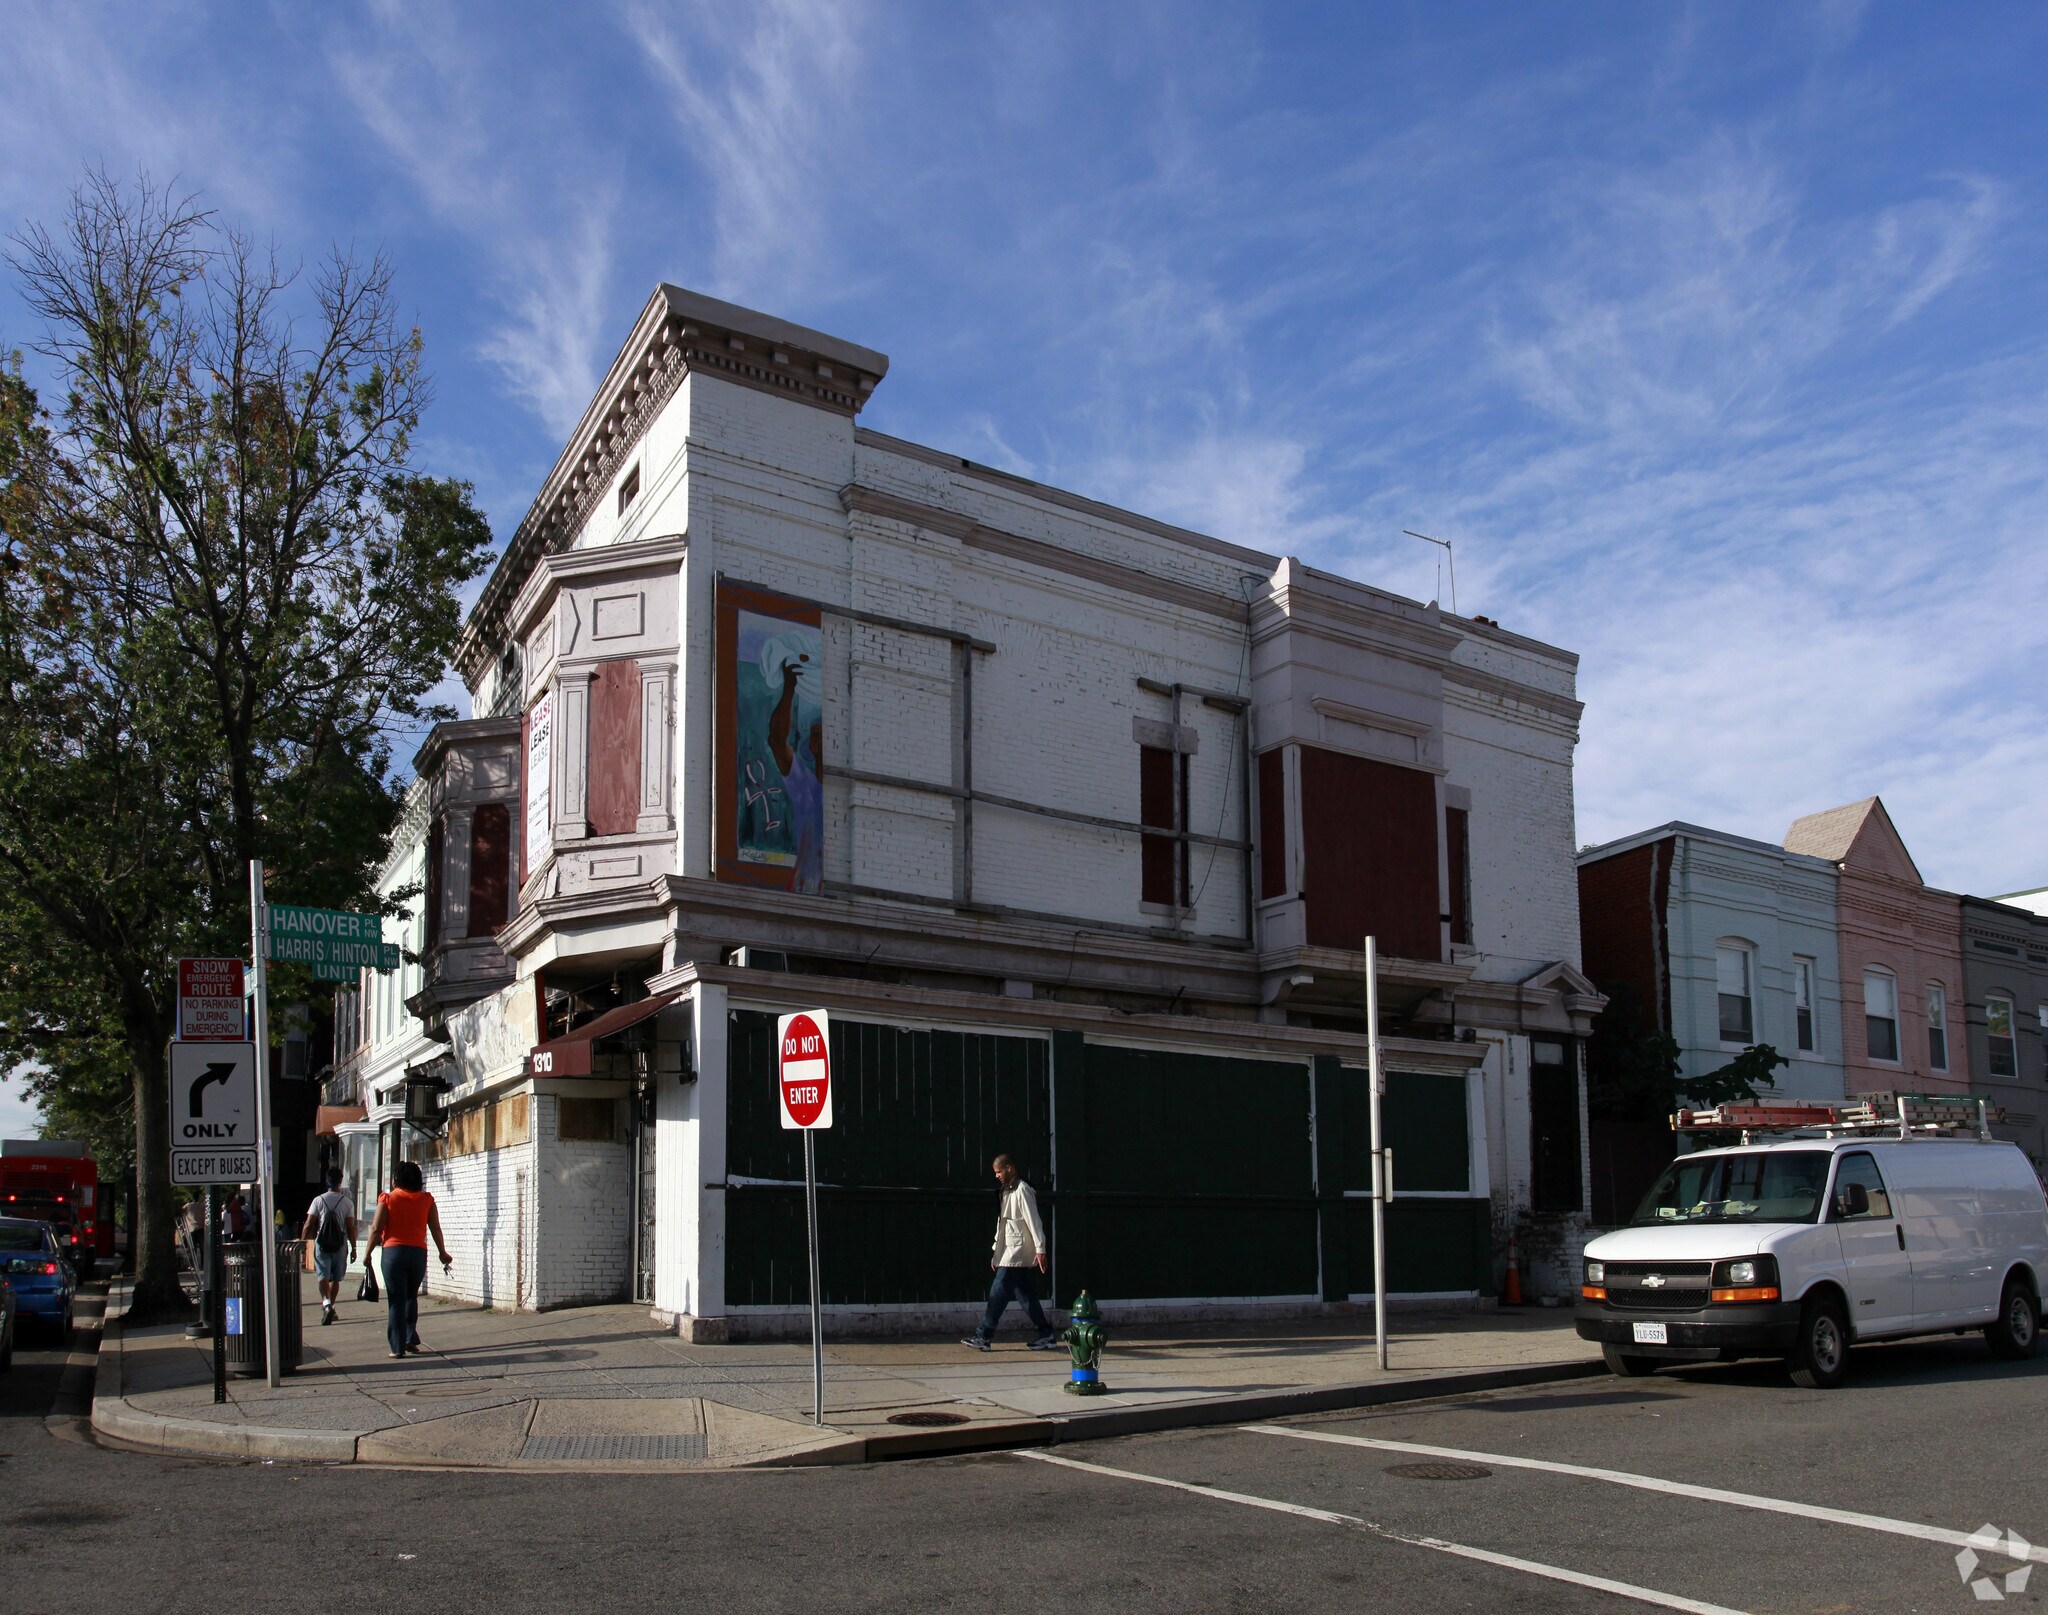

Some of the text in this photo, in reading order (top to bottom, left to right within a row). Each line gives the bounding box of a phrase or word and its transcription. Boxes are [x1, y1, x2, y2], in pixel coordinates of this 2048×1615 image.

[530, 697, 551, 732] LEASE
[530, 721, 550, 752] LEASE
[530, 743, 549, 769] LEASE
[273, 909, 360, 937] HANOVER
[364, 918, 377, 928] PL
[364, 929, 378, 938] NW
[276, 937, 378, 965] HARRIS/HINTON
[384, 946, 397, 955] PL
[193, 961, 230, 973] SNOW
[384, 957, 398, 966] NW
[186, 974, 236, 982] EMERGENCY
[317, 964, 356, 980] UNIT
[191, 984, 232, 995] ROUTE
[186, 999, 239, 1009] NO PARKING
[196, 1011, 229, 1021] DURING
[186, 1023, 239, 1034] EMERGENCY
[785, 1035, 820, 1055] DO NOT
[533, 1051, 553, 1073] 1310
[790, 1087, 819, 1105] ENTER
[183, 1124, 237, 1138] ONLY
[178, 1158, 215, 1175] EXCEPT
[220, 1157, 251, 1175] BUSES
